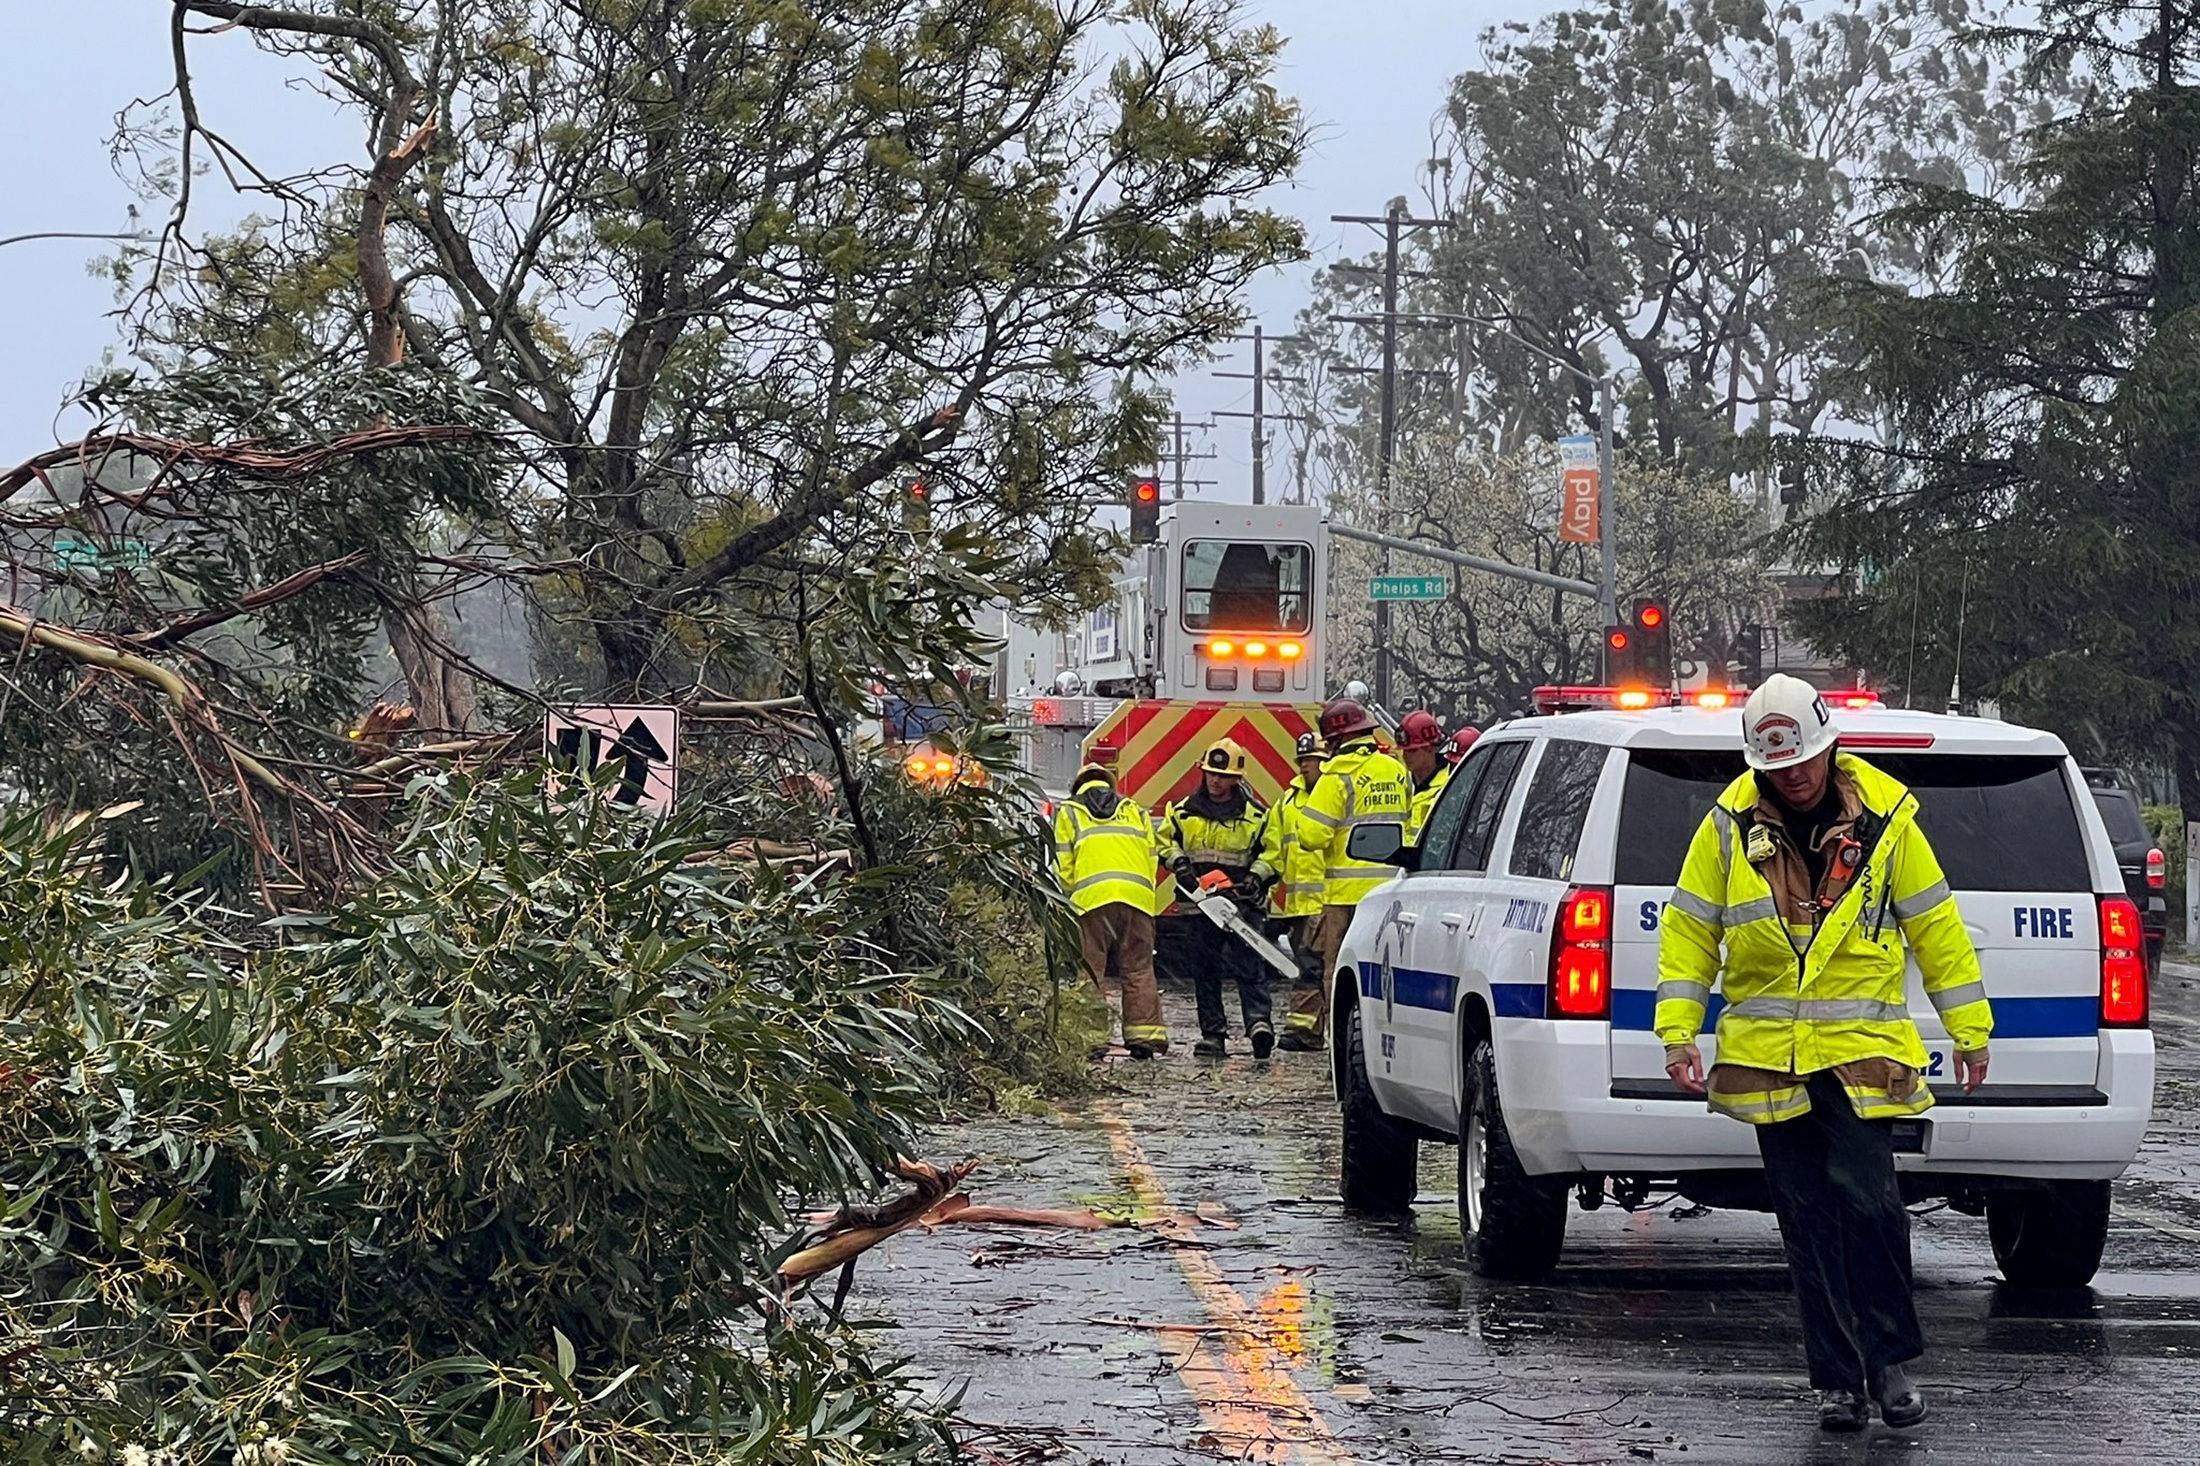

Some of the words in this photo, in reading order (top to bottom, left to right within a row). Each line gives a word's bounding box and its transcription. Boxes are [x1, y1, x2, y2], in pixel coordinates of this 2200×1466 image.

[1567, 478, 1594, 537] play
[1373, 583, 1419, 595] Phelps
[1425, 581, 1442, 593] Rd
[1364, 794, 1382, 807] FIRE
[2013, 907, 2073, 938] FIRE
